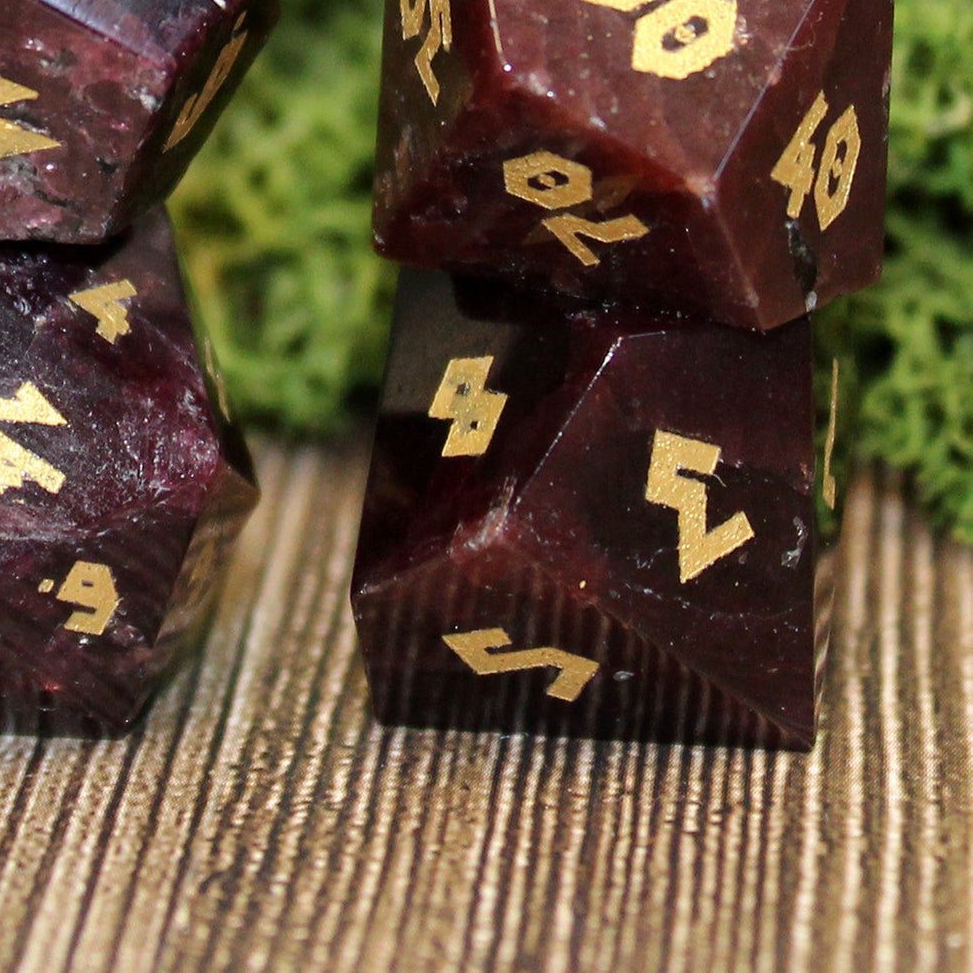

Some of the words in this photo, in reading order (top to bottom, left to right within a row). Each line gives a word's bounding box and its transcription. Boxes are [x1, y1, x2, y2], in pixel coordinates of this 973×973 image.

[769, 89, 861, 232] 40
[69, 278, 137, 345] 4
[428, 356, 508, 458] 8
